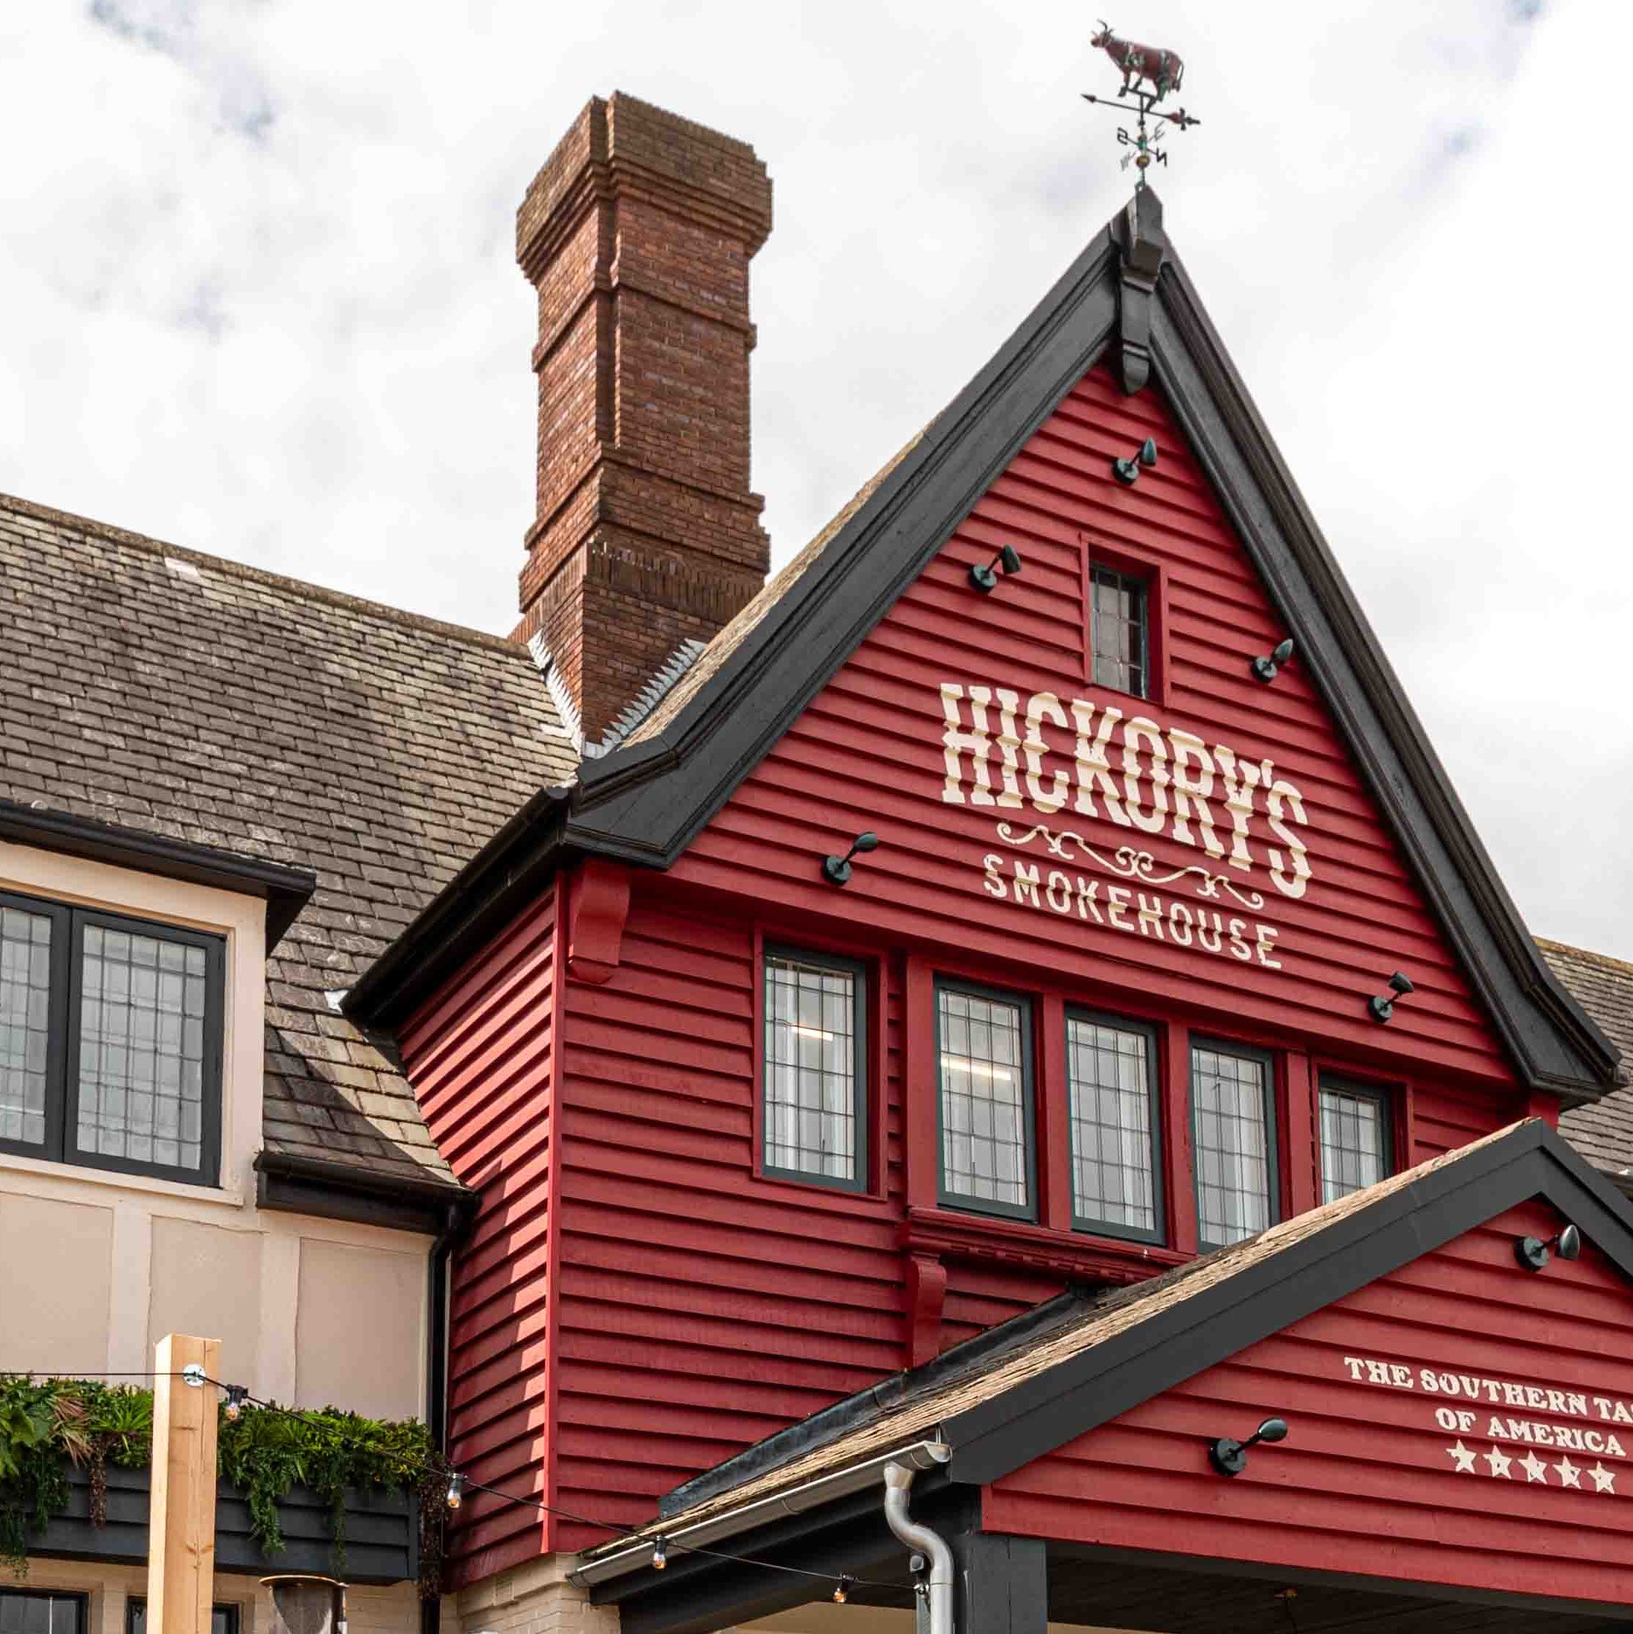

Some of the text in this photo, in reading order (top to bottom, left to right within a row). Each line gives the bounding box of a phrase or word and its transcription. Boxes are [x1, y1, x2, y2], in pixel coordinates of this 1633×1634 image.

[939, 683, 1313, 899] HICKORY'S
[983, 854, 1283, 969] SMOKEHOUSE
[1344, 1356, 1415, 1389] THE
[1419, 1369, 1588, 1417] SOUTHERN
[1435, 1407, 1627, 1457] OF AMERICA
